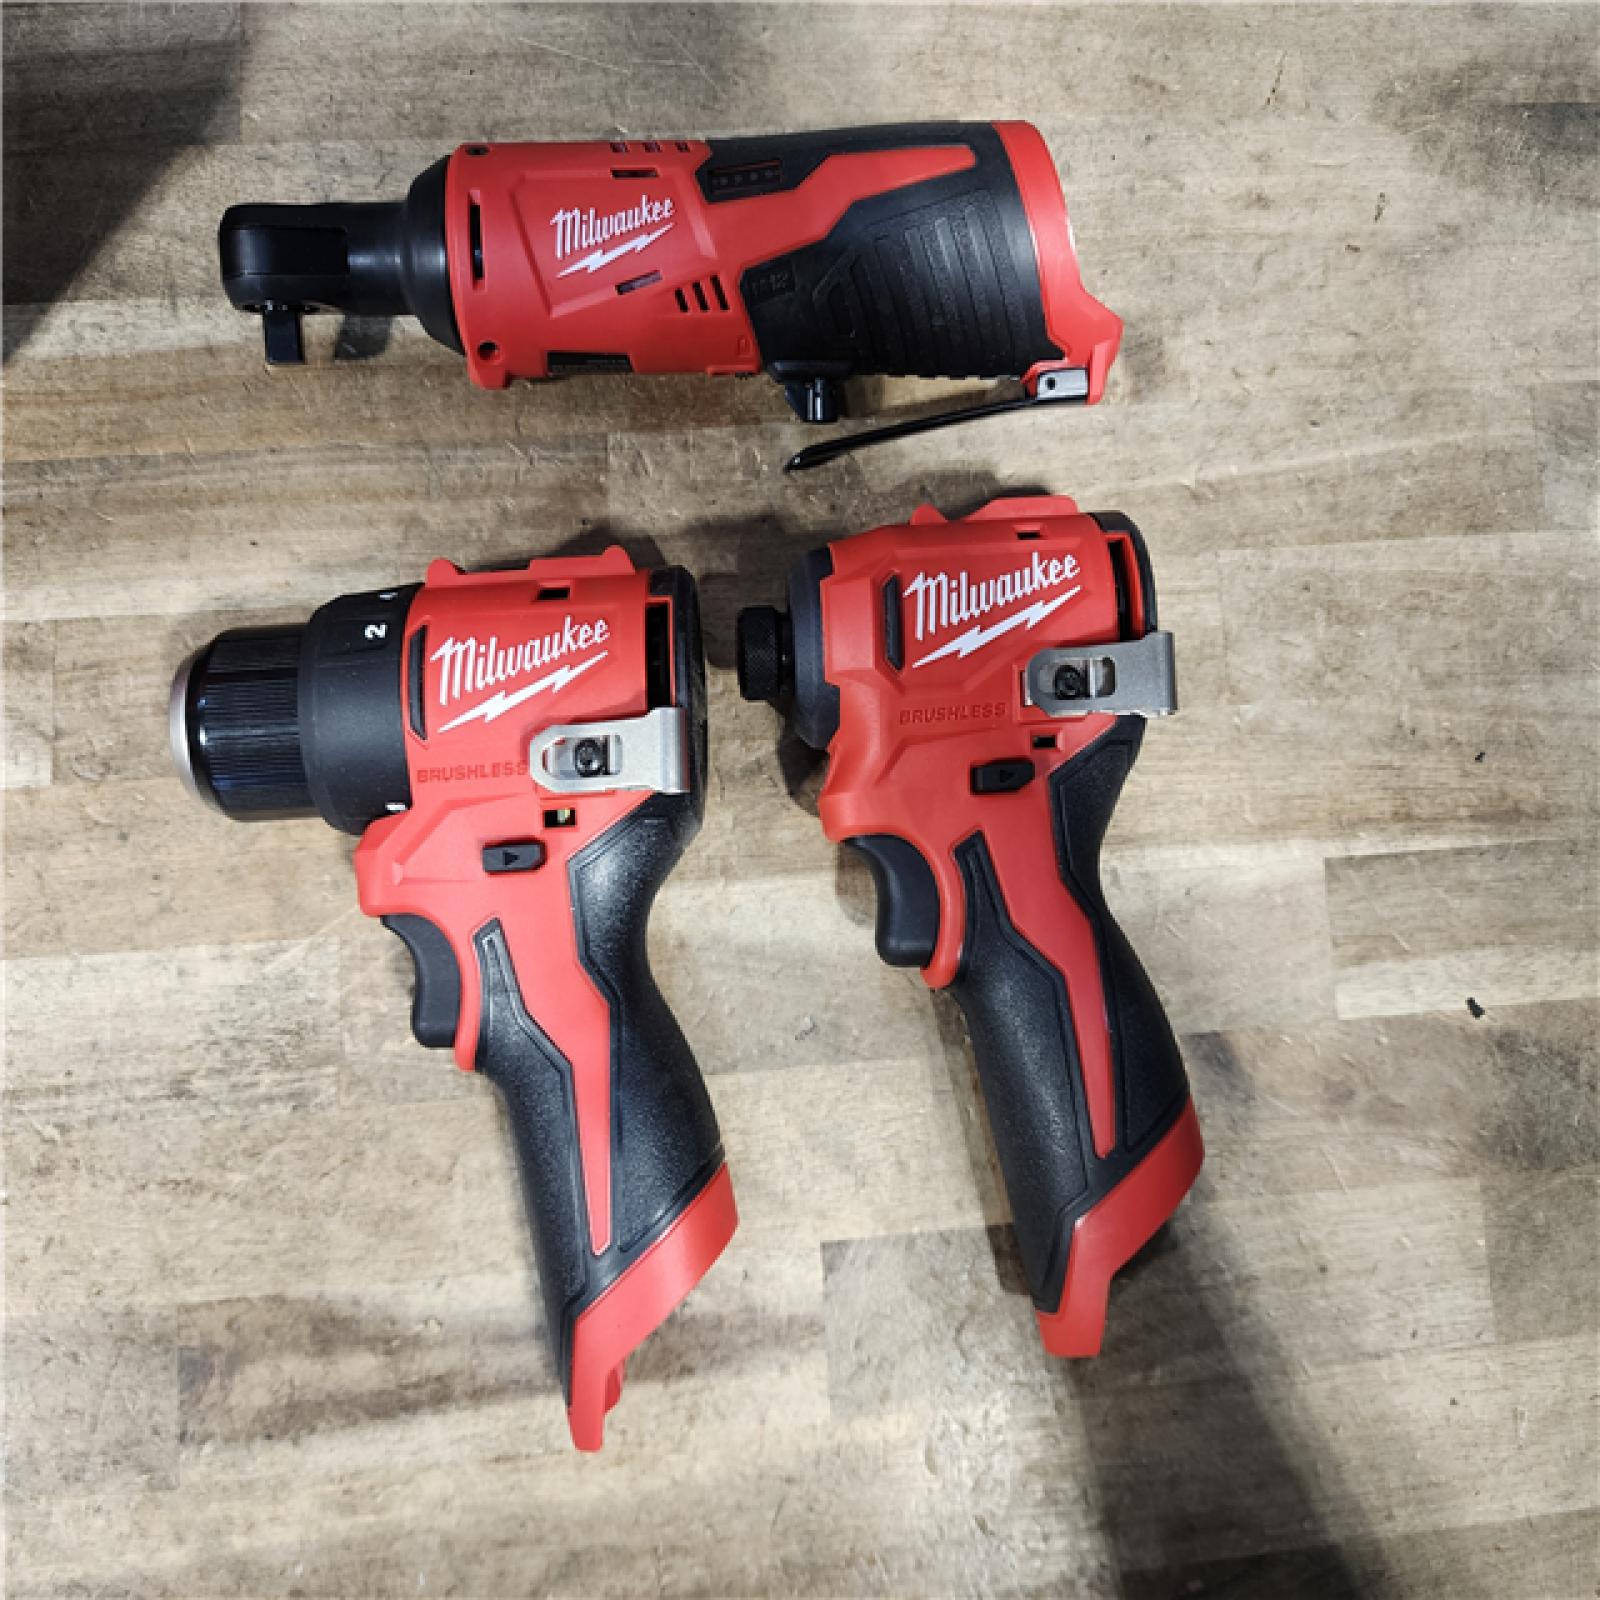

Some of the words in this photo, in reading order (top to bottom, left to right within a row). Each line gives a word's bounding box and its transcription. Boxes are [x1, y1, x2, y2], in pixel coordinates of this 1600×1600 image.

[549, 192, 675, 260] Milwaukee
[903, 551, 1080, 640] Milwaukee
[364, 623, 387, 640] 2
[430, 615, 610, 706] Milwaukee
[900, 702, 1006, 725] BRUSHLESS
[416, 761, 528, 783] BRUSHLESS
